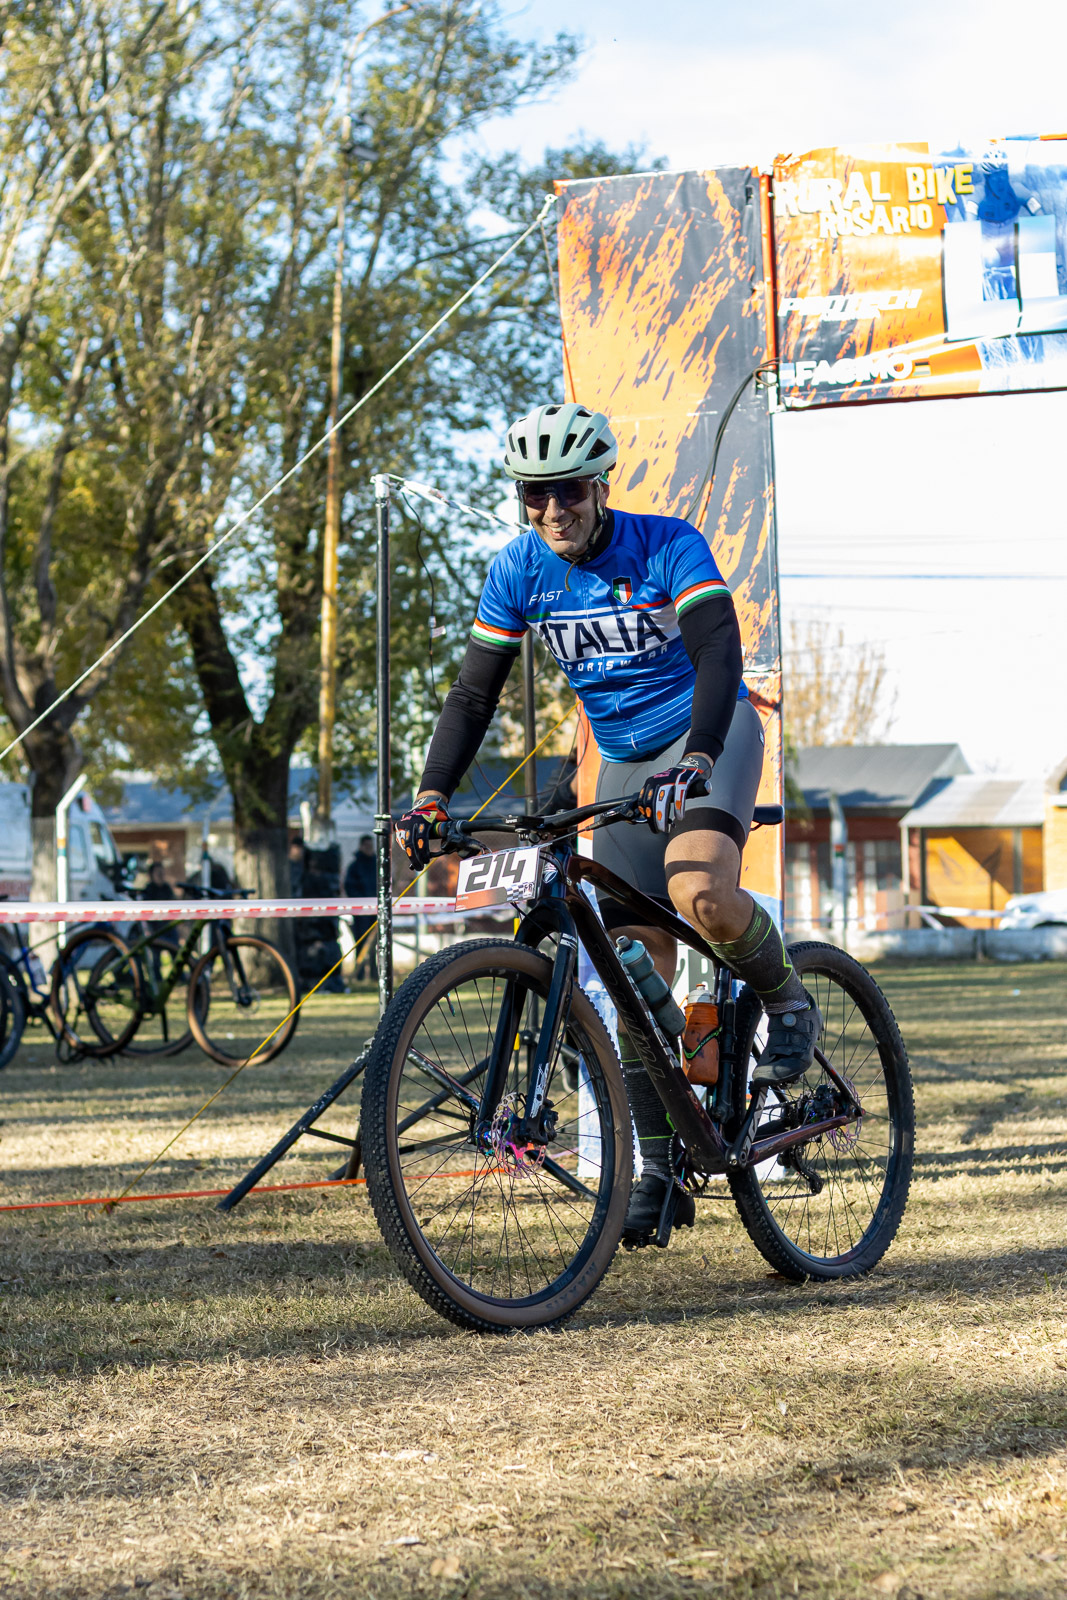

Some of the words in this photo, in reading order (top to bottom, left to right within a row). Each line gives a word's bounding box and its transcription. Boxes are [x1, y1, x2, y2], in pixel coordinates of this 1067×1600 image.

[774, 171, 891, 217] RURAL
[907, 164, 974, 205] BIKE
[819, 203, 934, 239] ROSARIO
[528, 590, 564, 605] FAST
[540, 613, 668, 660] ITALIA
[465, 852, 527, 892] 214
